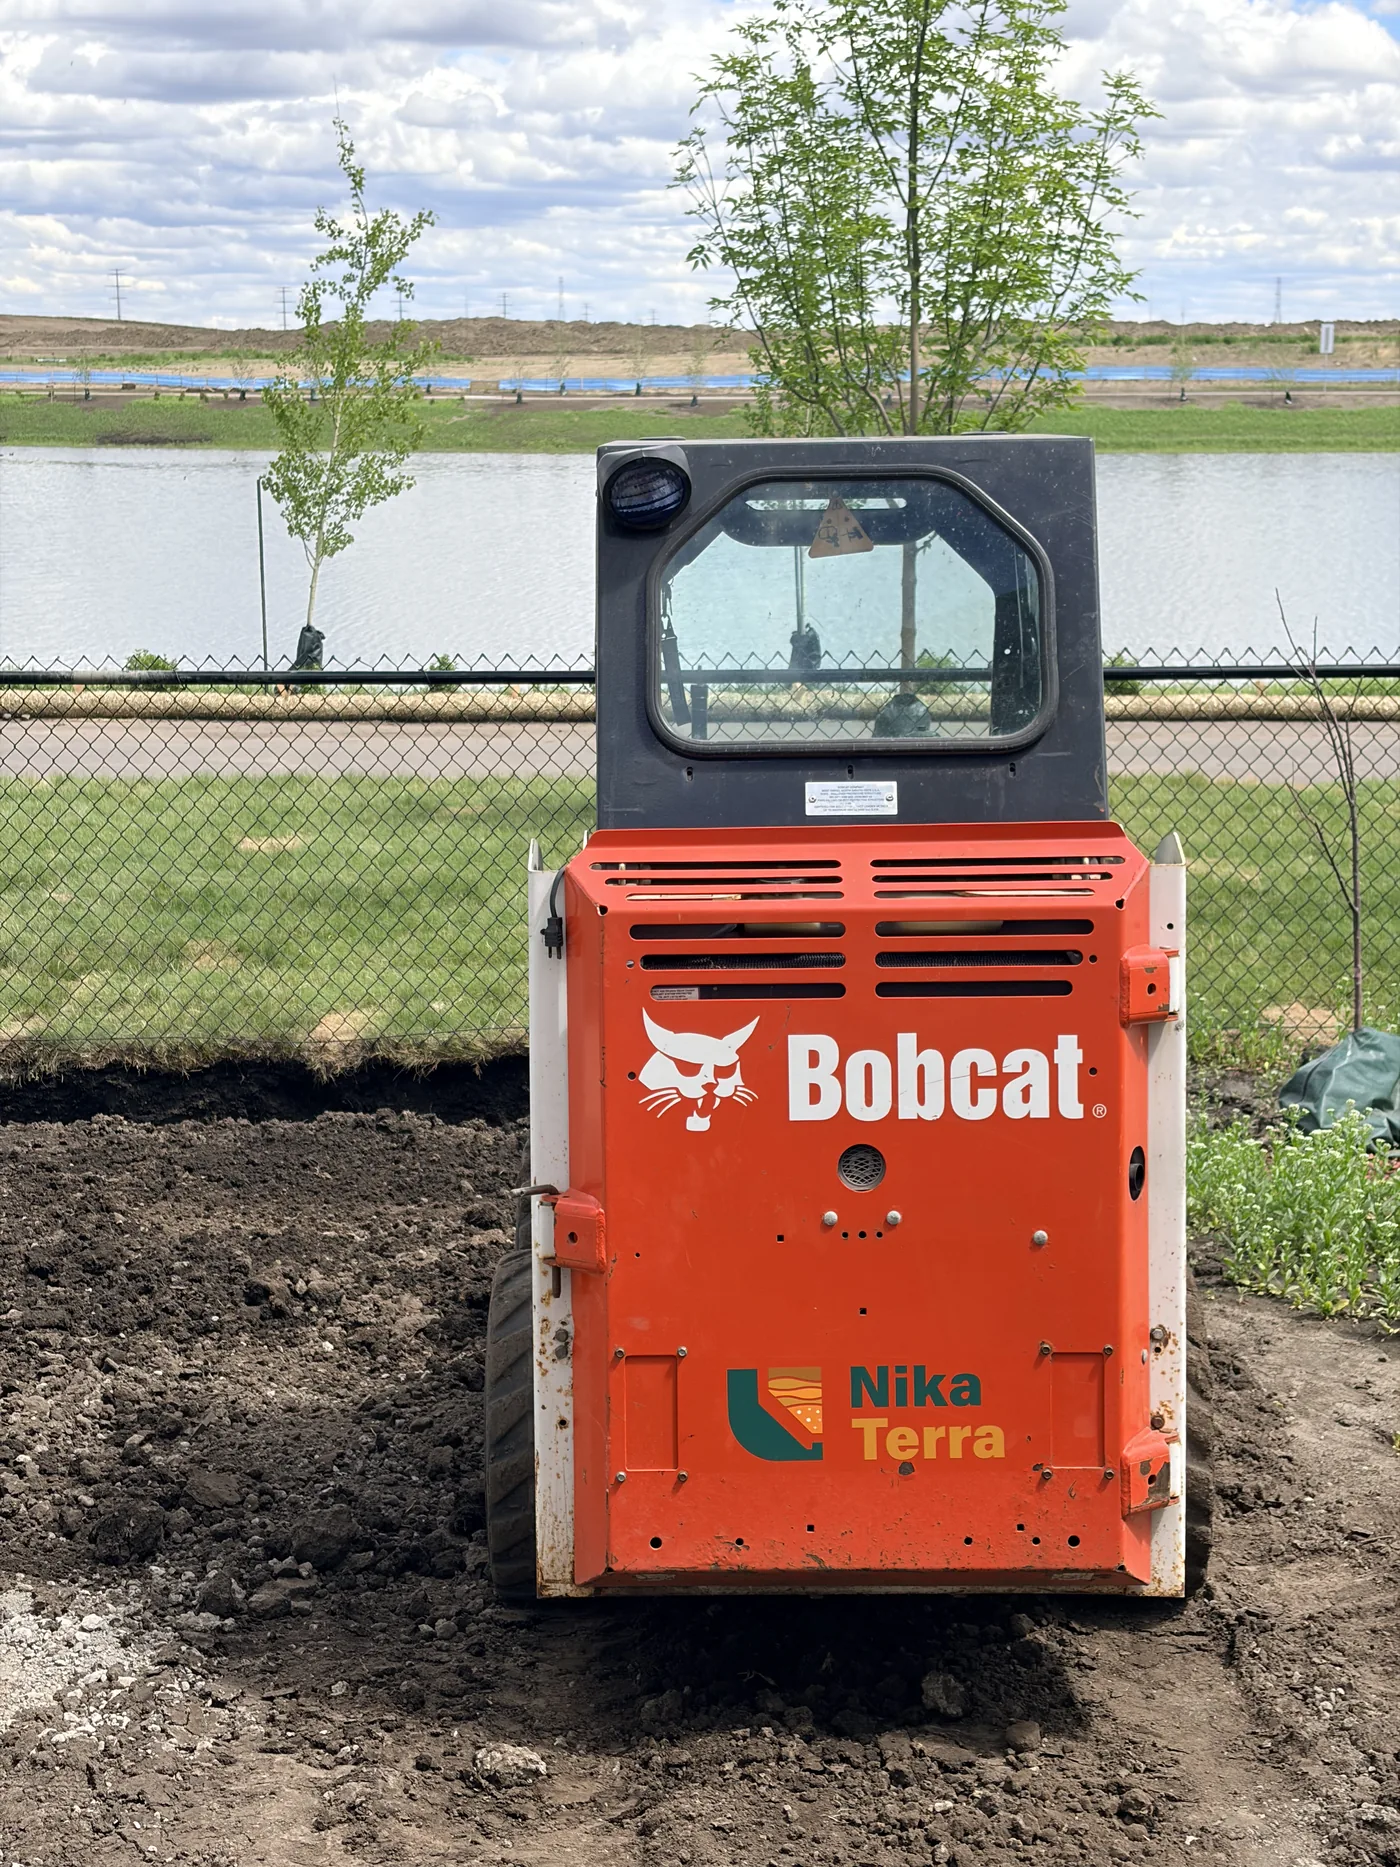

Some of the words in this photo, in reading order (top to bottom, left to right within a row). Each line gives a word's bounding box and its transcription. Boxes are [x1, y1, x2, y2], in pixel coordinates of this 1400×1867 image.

[787, 1032, 1084, 1122] Bobcat
[850, 1365, 982, 1408] Nika
[851, 1418, 1005, 1460] Terra
